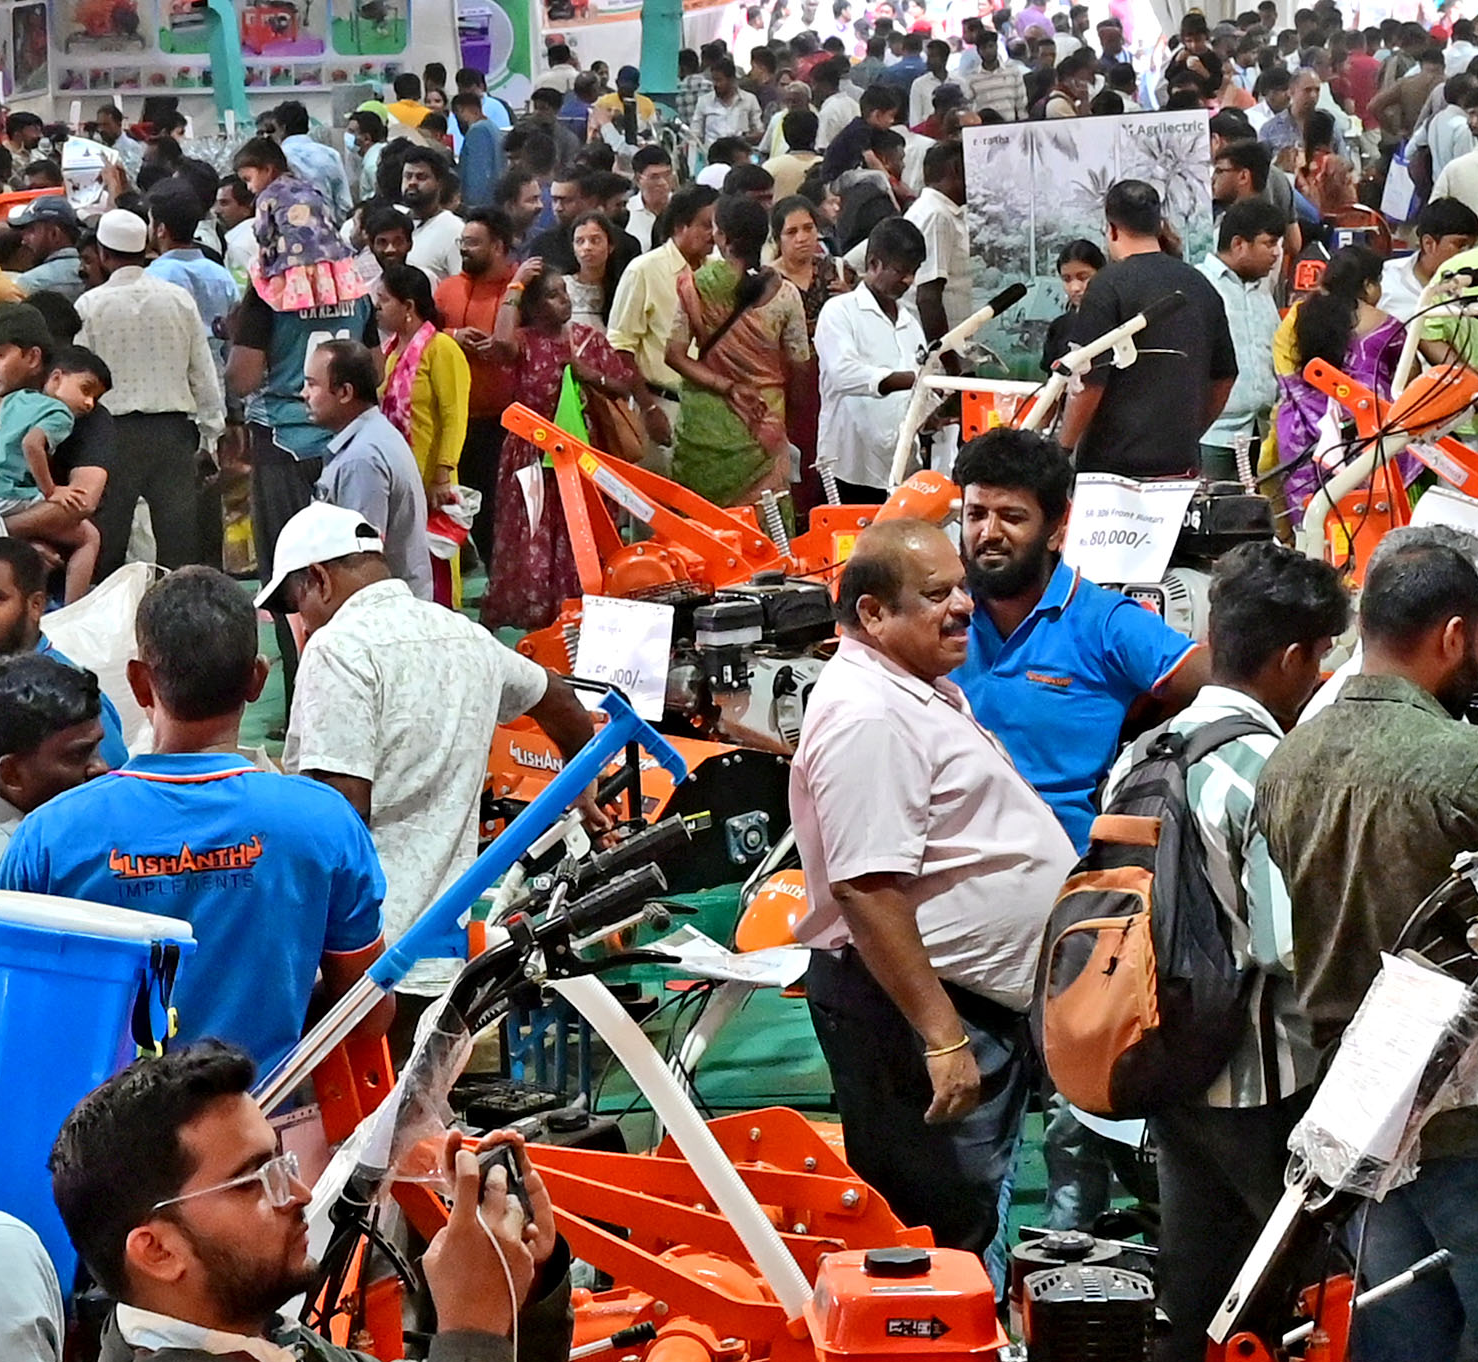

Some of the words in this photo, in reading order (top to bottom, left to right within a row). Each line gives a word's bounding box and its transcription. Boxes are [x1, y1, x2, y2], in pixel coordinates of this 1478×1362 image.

[1136, 120, 1205, 137] Agrilectric
[1111, 508, 1134, 520] Front
[118, 873, 255, 899] IMPLEMENTS
